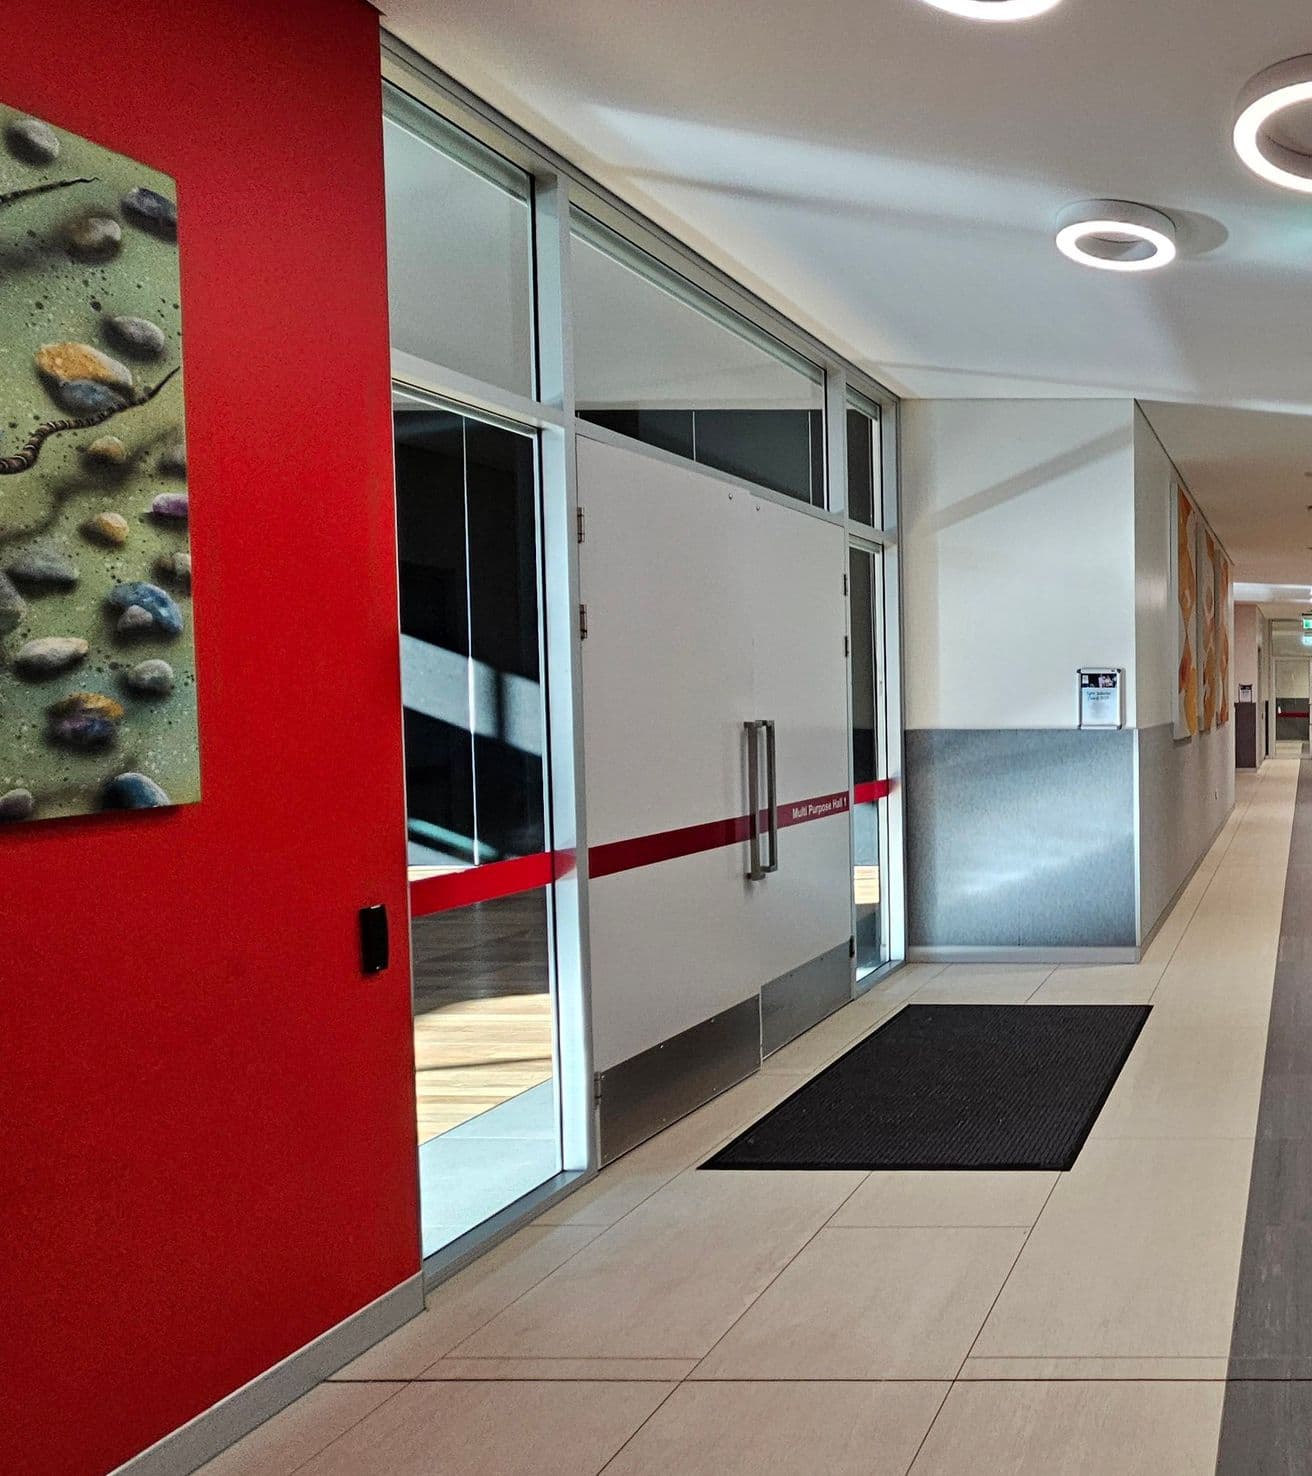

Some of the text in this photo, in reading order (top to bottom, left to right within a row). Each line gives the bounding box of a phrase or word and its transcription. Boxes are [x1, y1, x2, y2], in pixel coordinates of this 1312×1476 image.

[792, 805, 808, 819] Multi
[808, 802, 832, 815] Purpose
[832, 798, 843, 809] Hall
